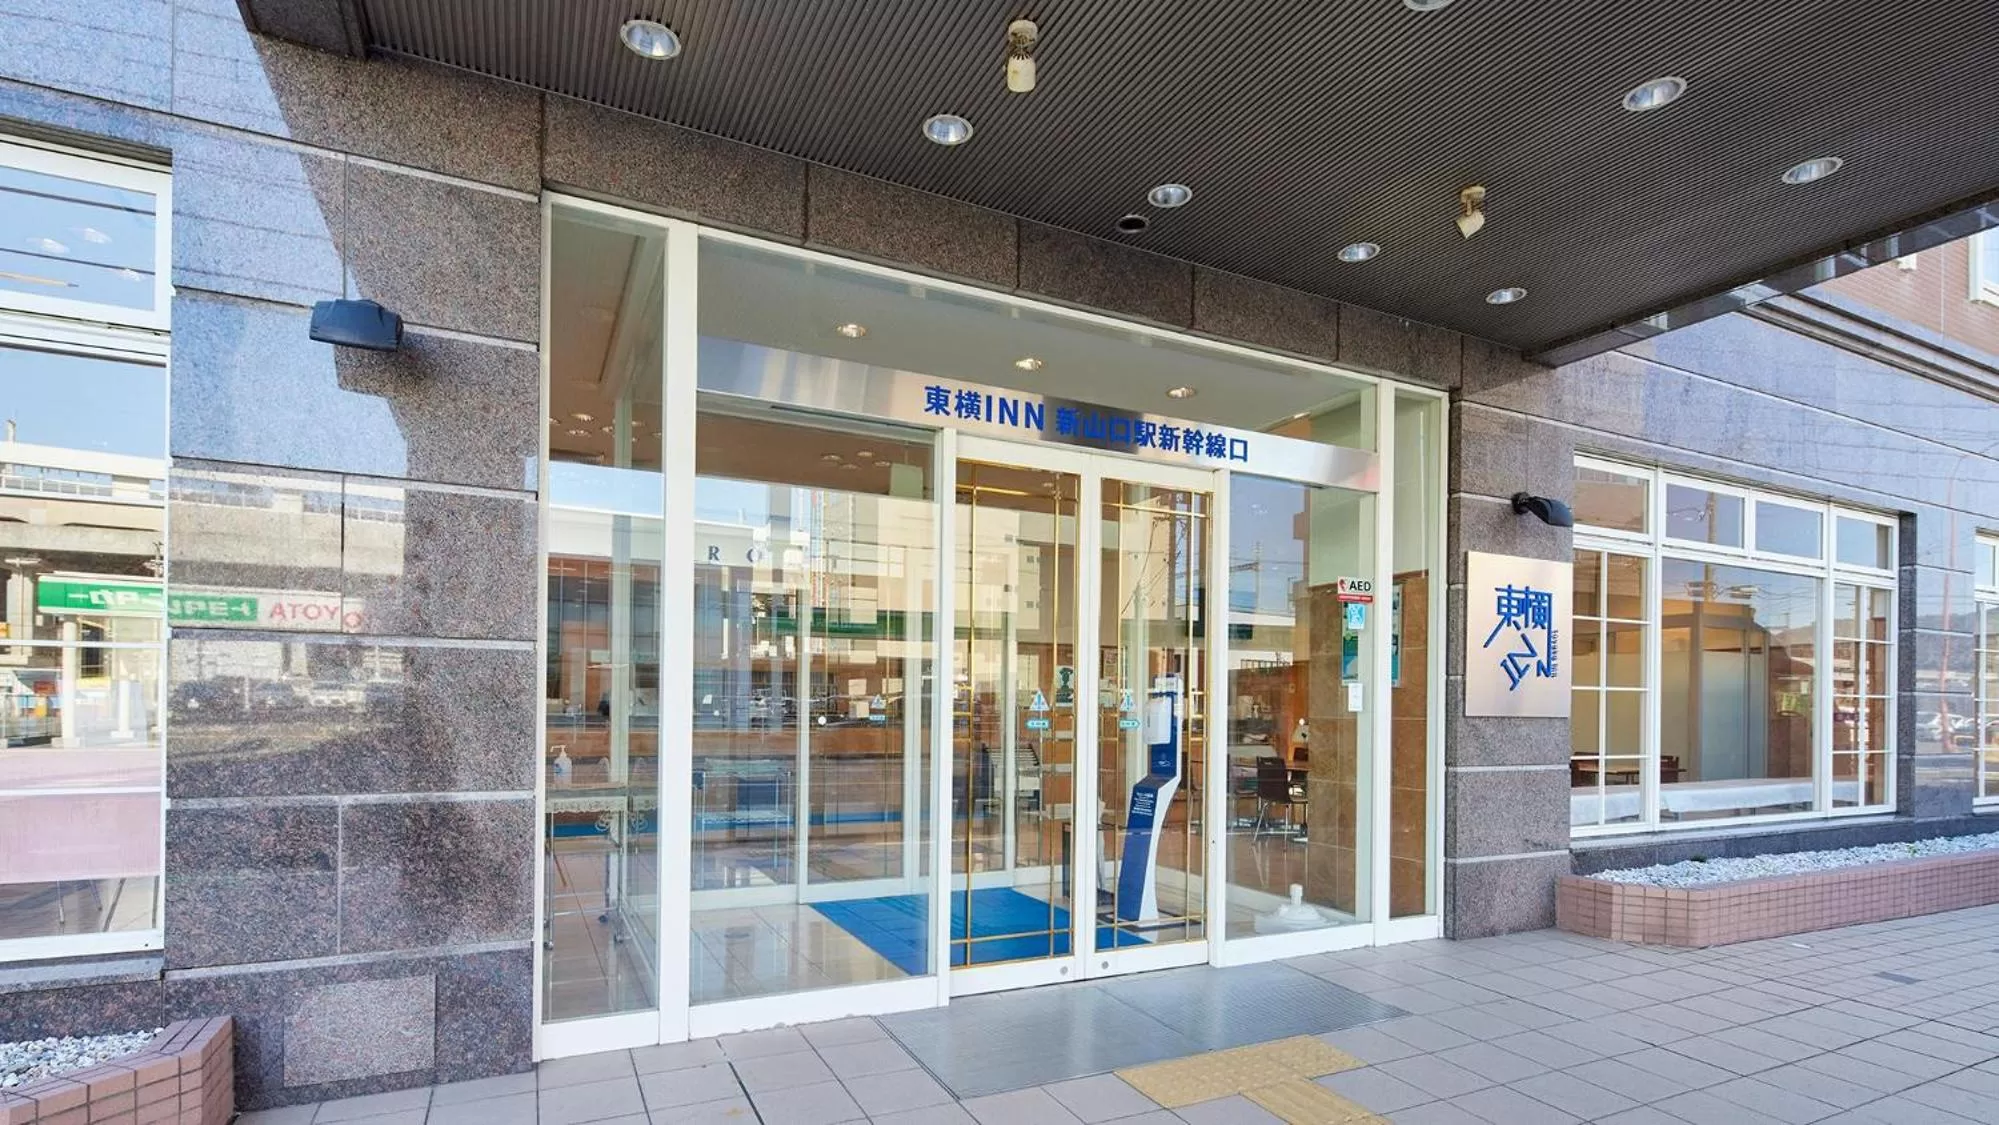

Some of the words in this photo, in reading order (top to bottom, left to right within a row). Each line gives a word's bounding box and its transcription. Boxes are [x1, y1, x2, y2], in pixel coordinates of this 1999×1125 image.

[923, 384, 1045, 432] 東横INN
[1056, 406, 1249, 463] 新山口駅新幹線口
[1349, 580, 1371, 592] AED
